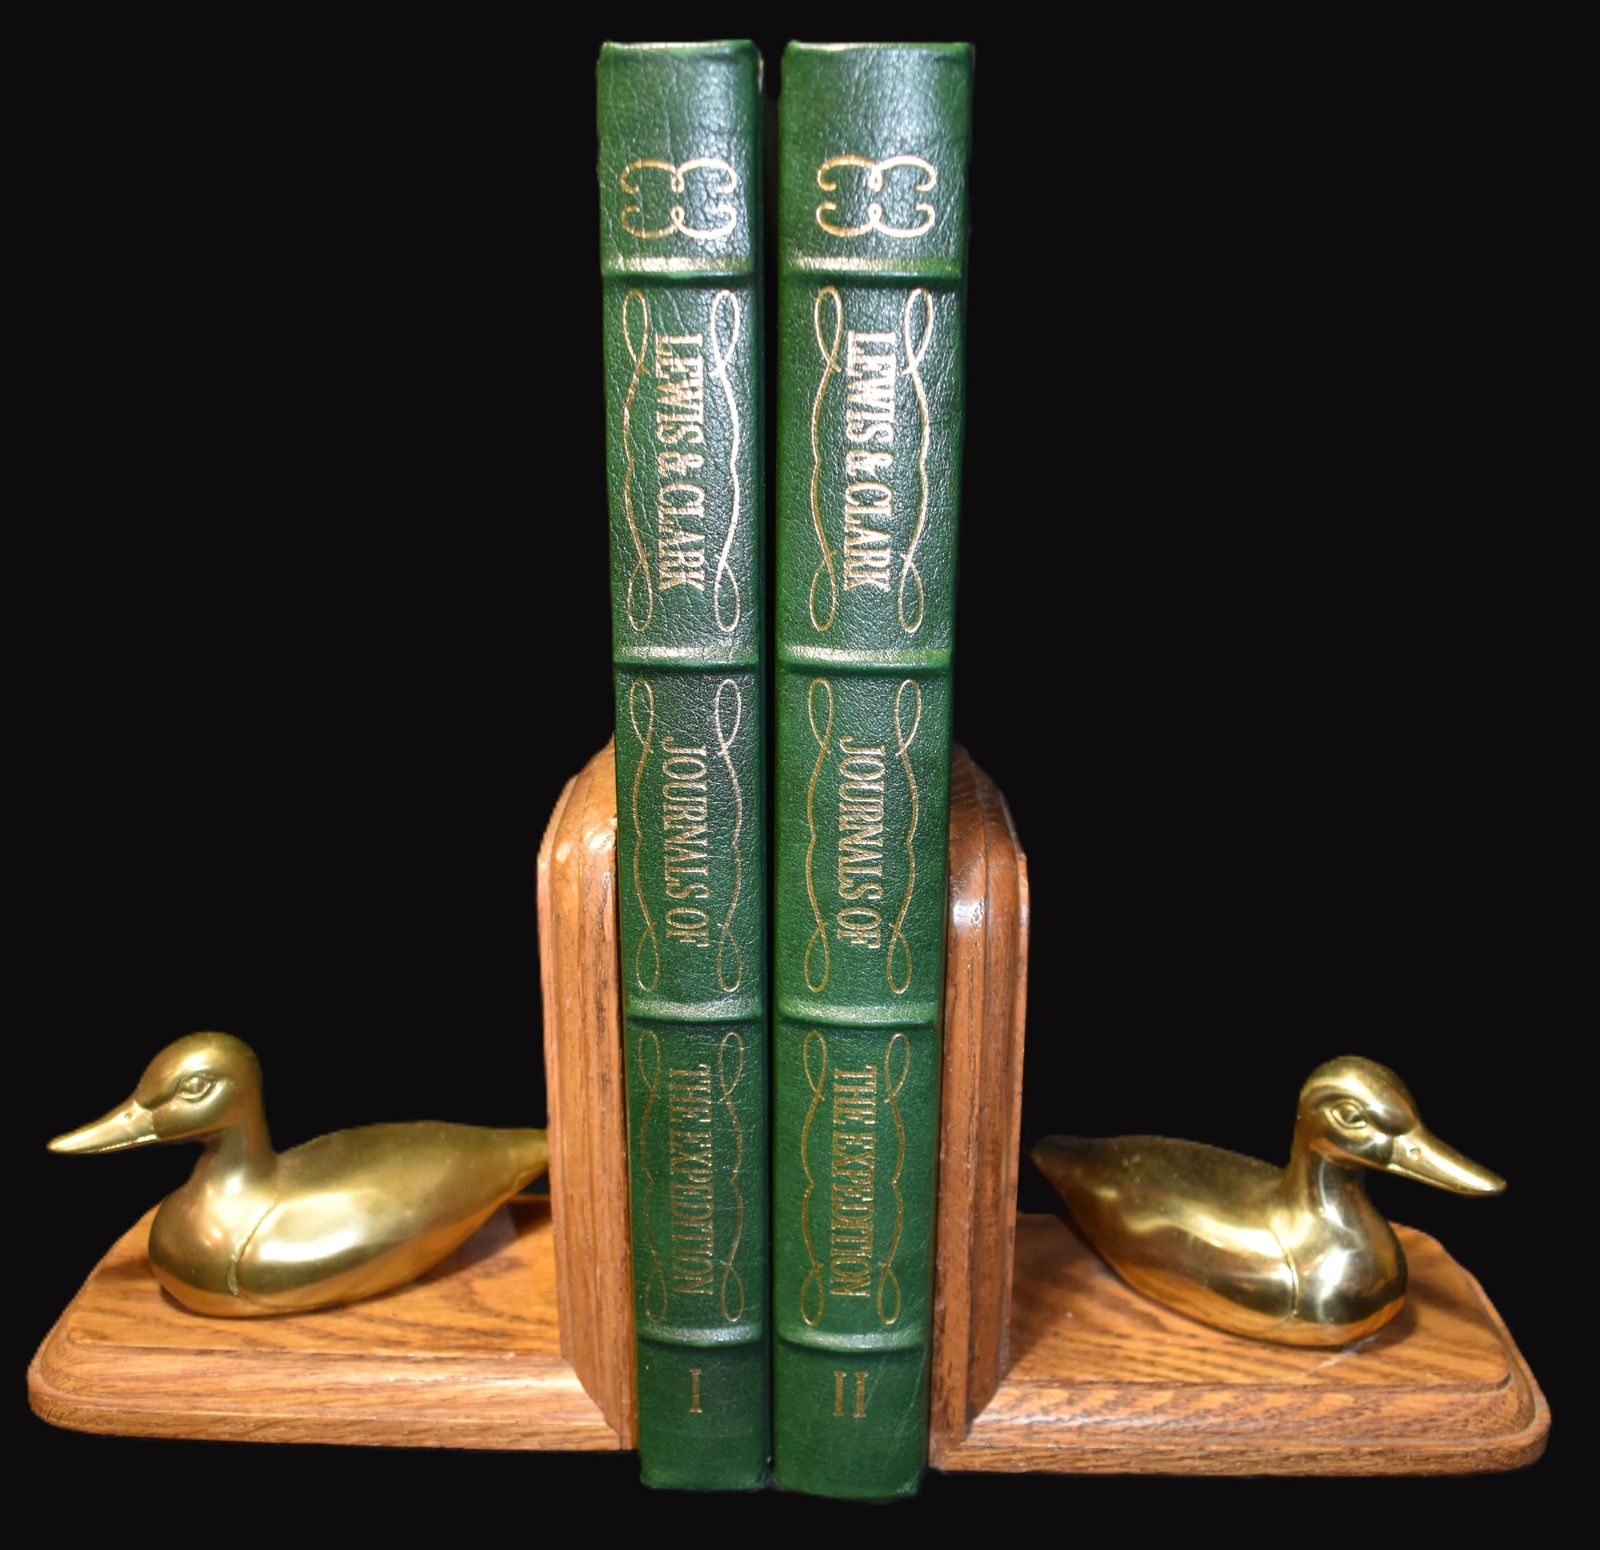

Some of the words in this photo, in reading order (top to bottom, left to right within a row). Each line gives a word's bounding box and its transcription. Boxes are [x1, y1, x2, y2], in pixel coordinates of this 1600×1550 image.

[655, 332, 705, 445] LEWIS
[845, 330, 897, 443] LEWIS
[656, 450, 705, 478] &
[846, 450, 894, 478] &
[657, 482, 706, 592] CLARK
[844, 481, 894, 592] CLARK
[661, 735, 709, 900] JOURNALS
[837, 735, 886, 900] JOURNALS
[664, 906, 710, 948] OF
[836, 906, 882, 949] OF
[668, 1063, 712, 1123] THE
[832, 1064, 877, 1125] THE
[669, 1131, 714, 1296] EXPEDITION
[829, 1131, 876, 1297] EXPEDITION
[689, 1368, 702, 1414] I
[832, 1371, 869, 1417] II
